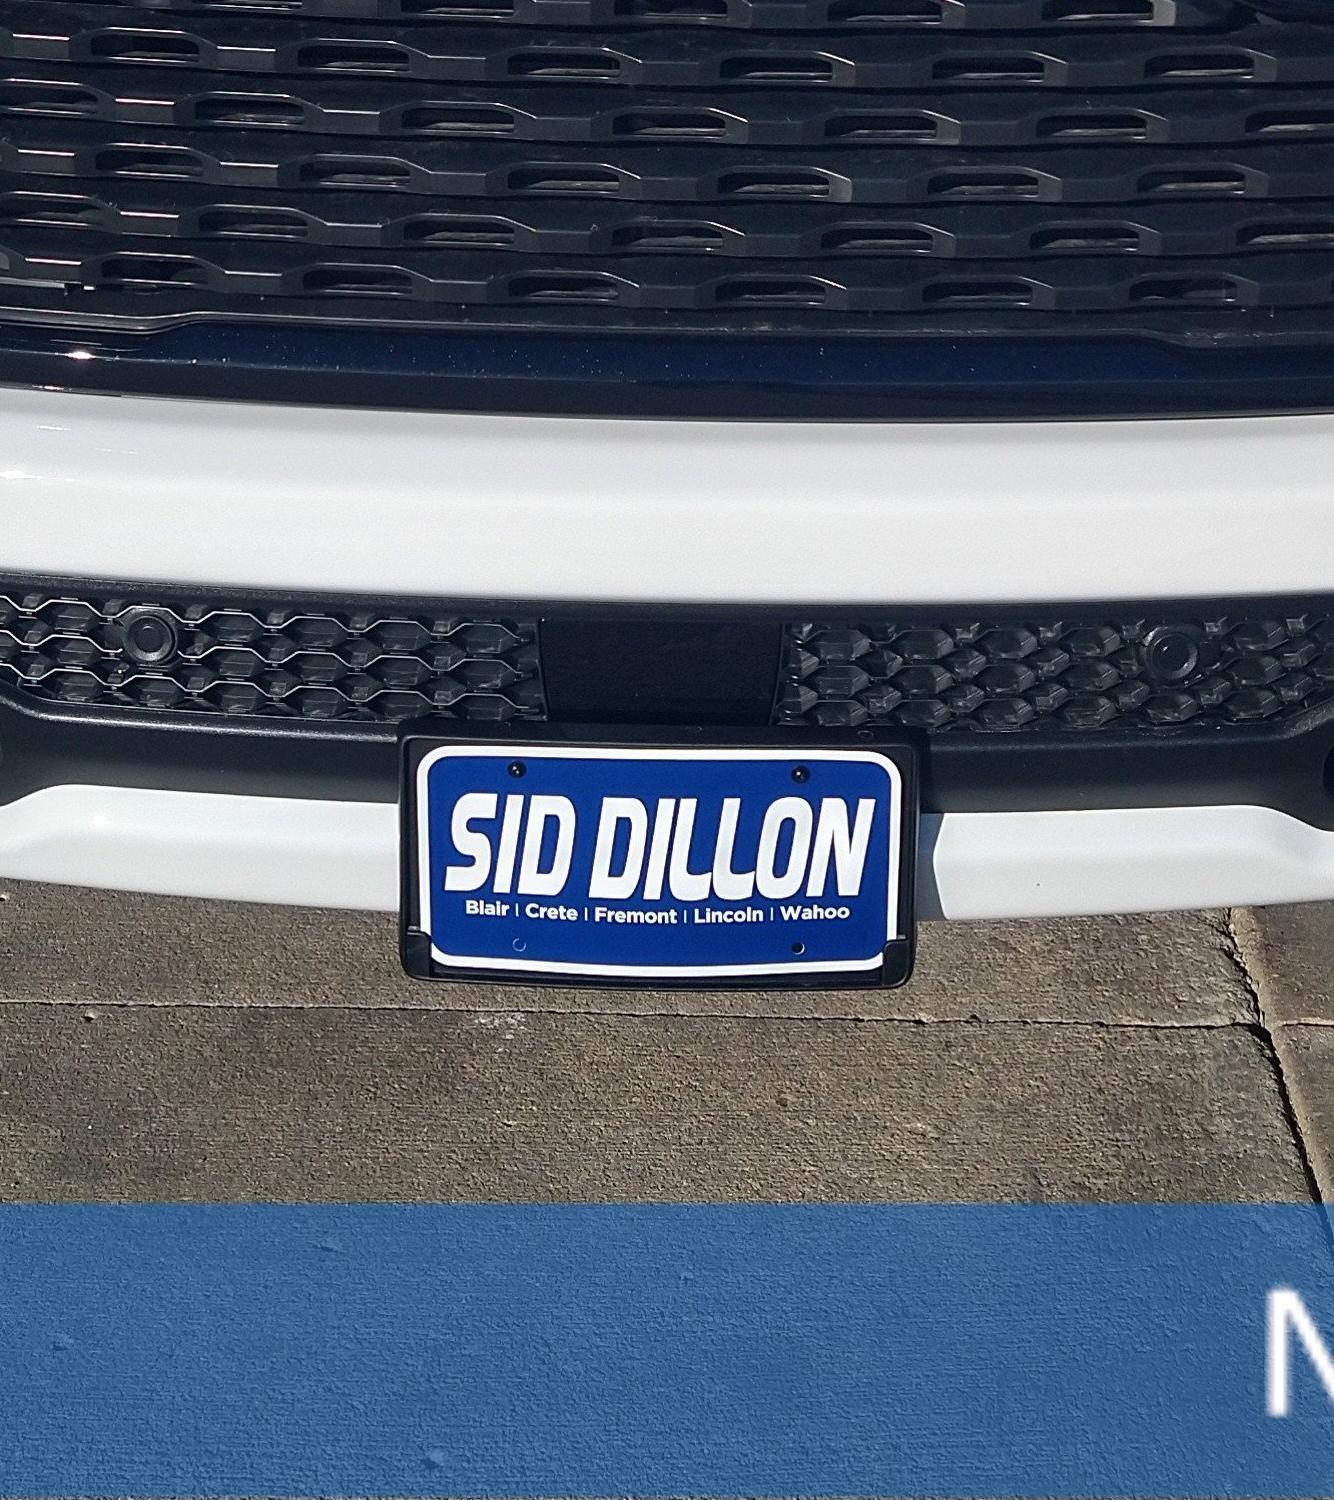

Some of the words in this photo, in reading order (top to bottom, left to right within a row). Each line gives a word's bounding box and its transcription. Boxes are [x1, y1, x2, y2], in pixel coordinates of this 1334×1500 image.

[444, 792, 577, 895] SID
[588, 796, 876, 901] DILLON
[465, 899, 510, 917] Blair
[525, 903, 578, 921] Crete
[594, 906, 678, 925] Fremont
[694, 907, 764, 924] Lincoln
[780, 905, 850, 920] Wahoo
